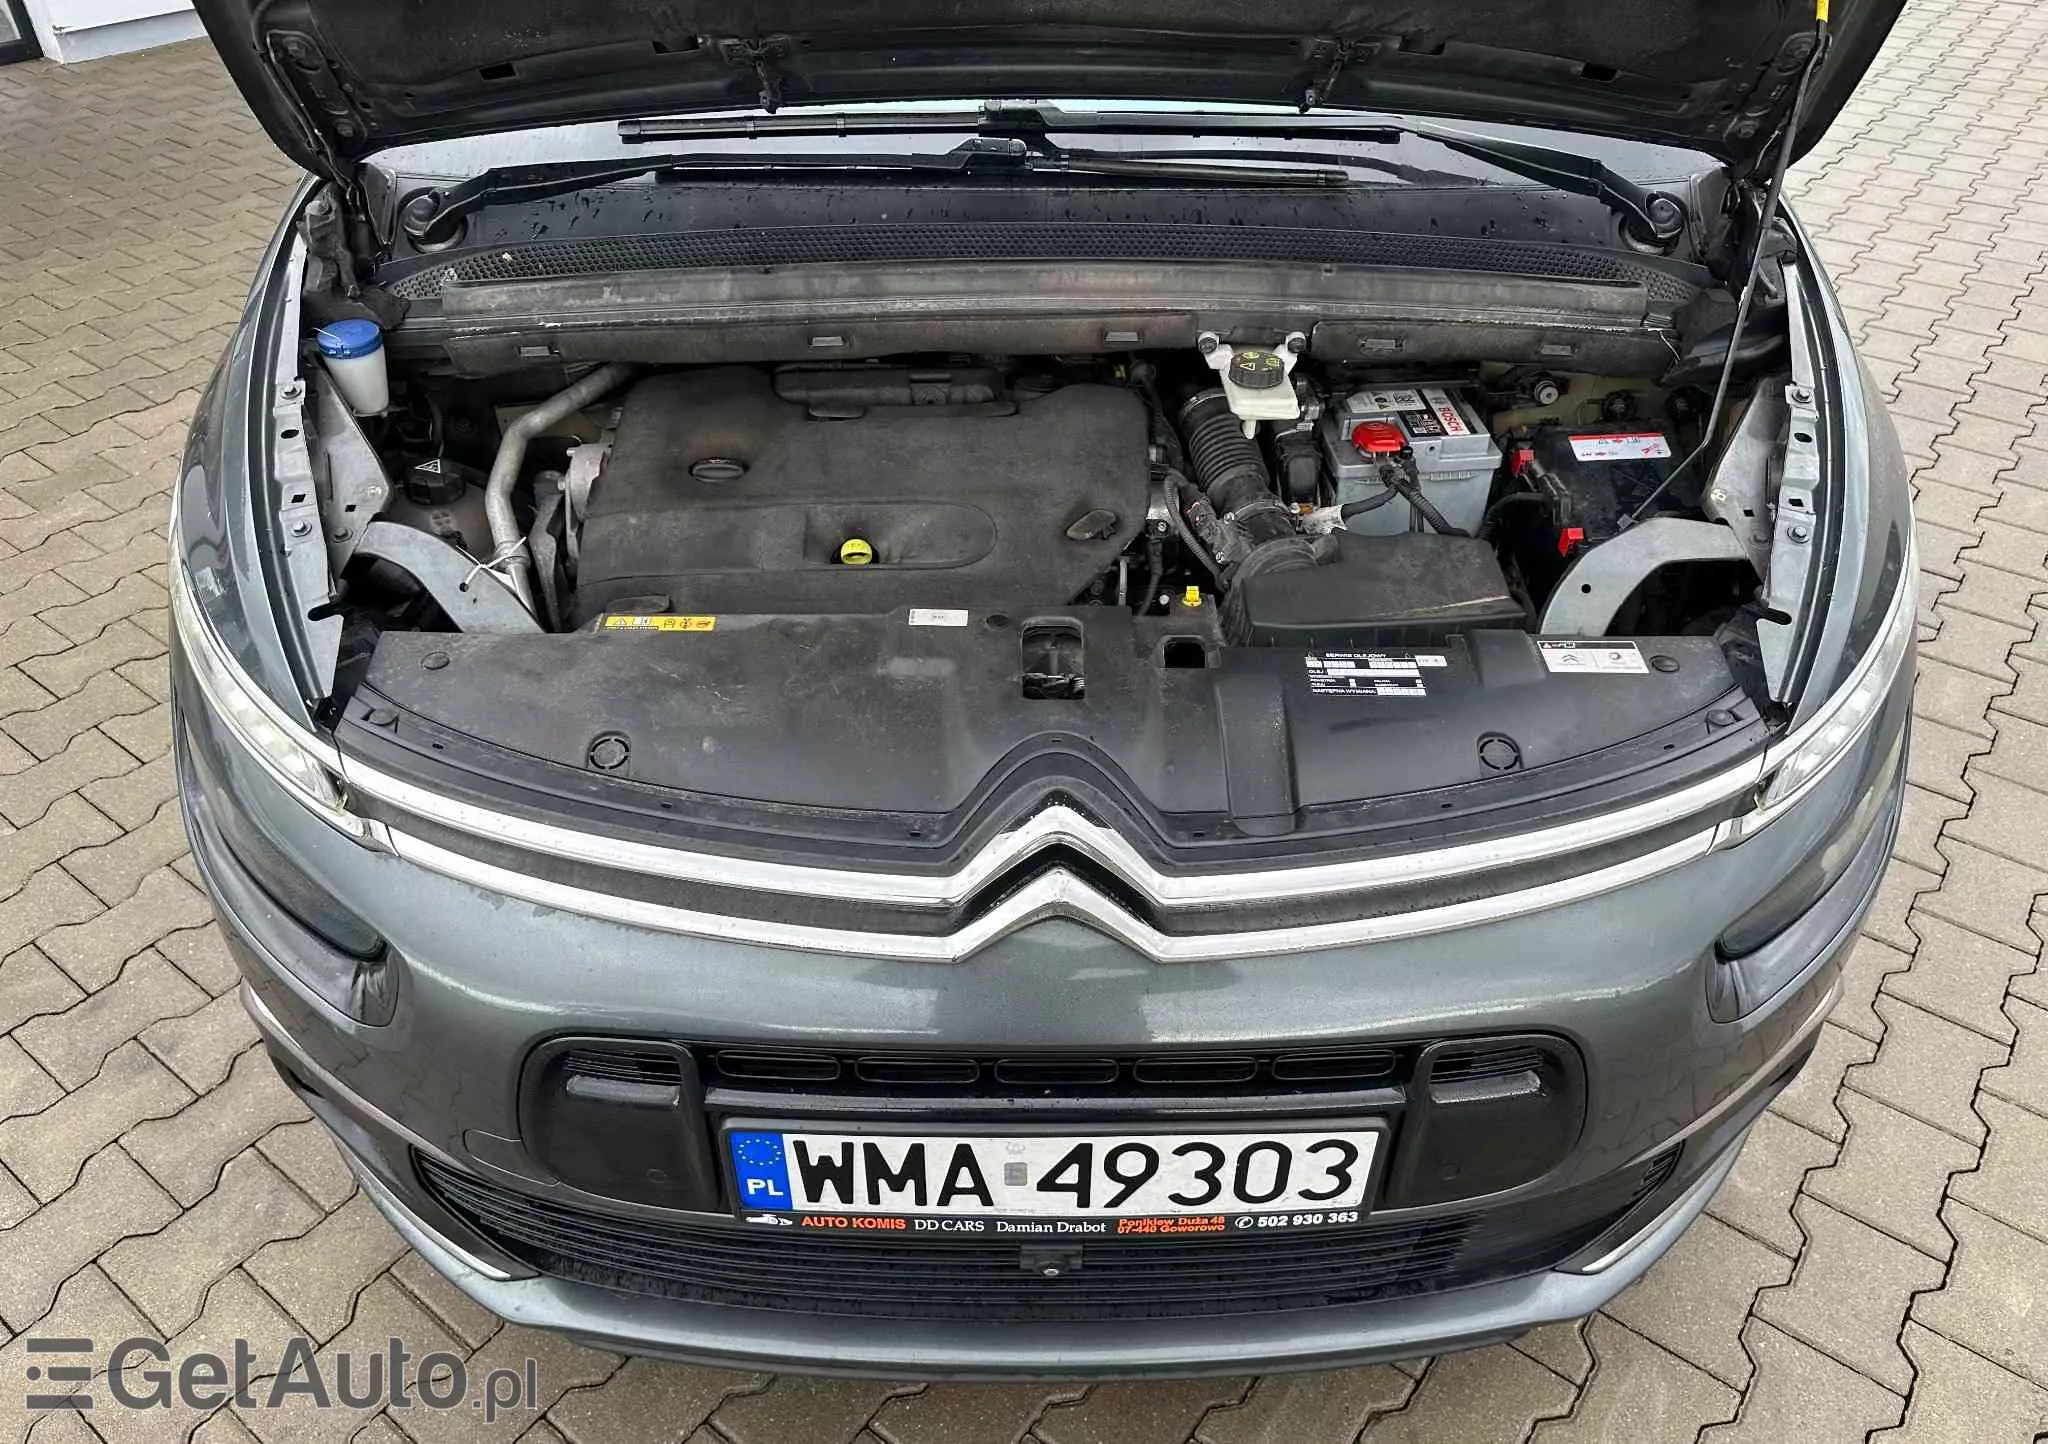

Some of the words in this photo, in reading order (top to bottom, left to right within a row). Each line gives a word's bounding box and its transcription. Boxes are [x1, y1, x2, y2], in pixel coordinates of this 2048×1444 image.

[1441, 407, 1462, 432] BOSCH
[793, 1140, 994, 1206] WMA
[1036, 1139, 1359, 1209] 49303
[747, 1178, 784, 1196] PL
[801, 1215, 848, 1229] AUTO
[851, 1217, 907, 1230] KOMIS
[914, 1219, 940, 1231] DD
[941, 1219, 985, 1232] CARS
[996, 1221, 1052, 1233] Damian
[1056, 1220, 1106, 1233] Drabot
[1160, 1224, 1225, 1233] Goworowo
[1257, 1214, 1288, 1228] 502
[1292, 1213, 1323, 1226] 930
[1327, 1211, 1359, 1225] 363
